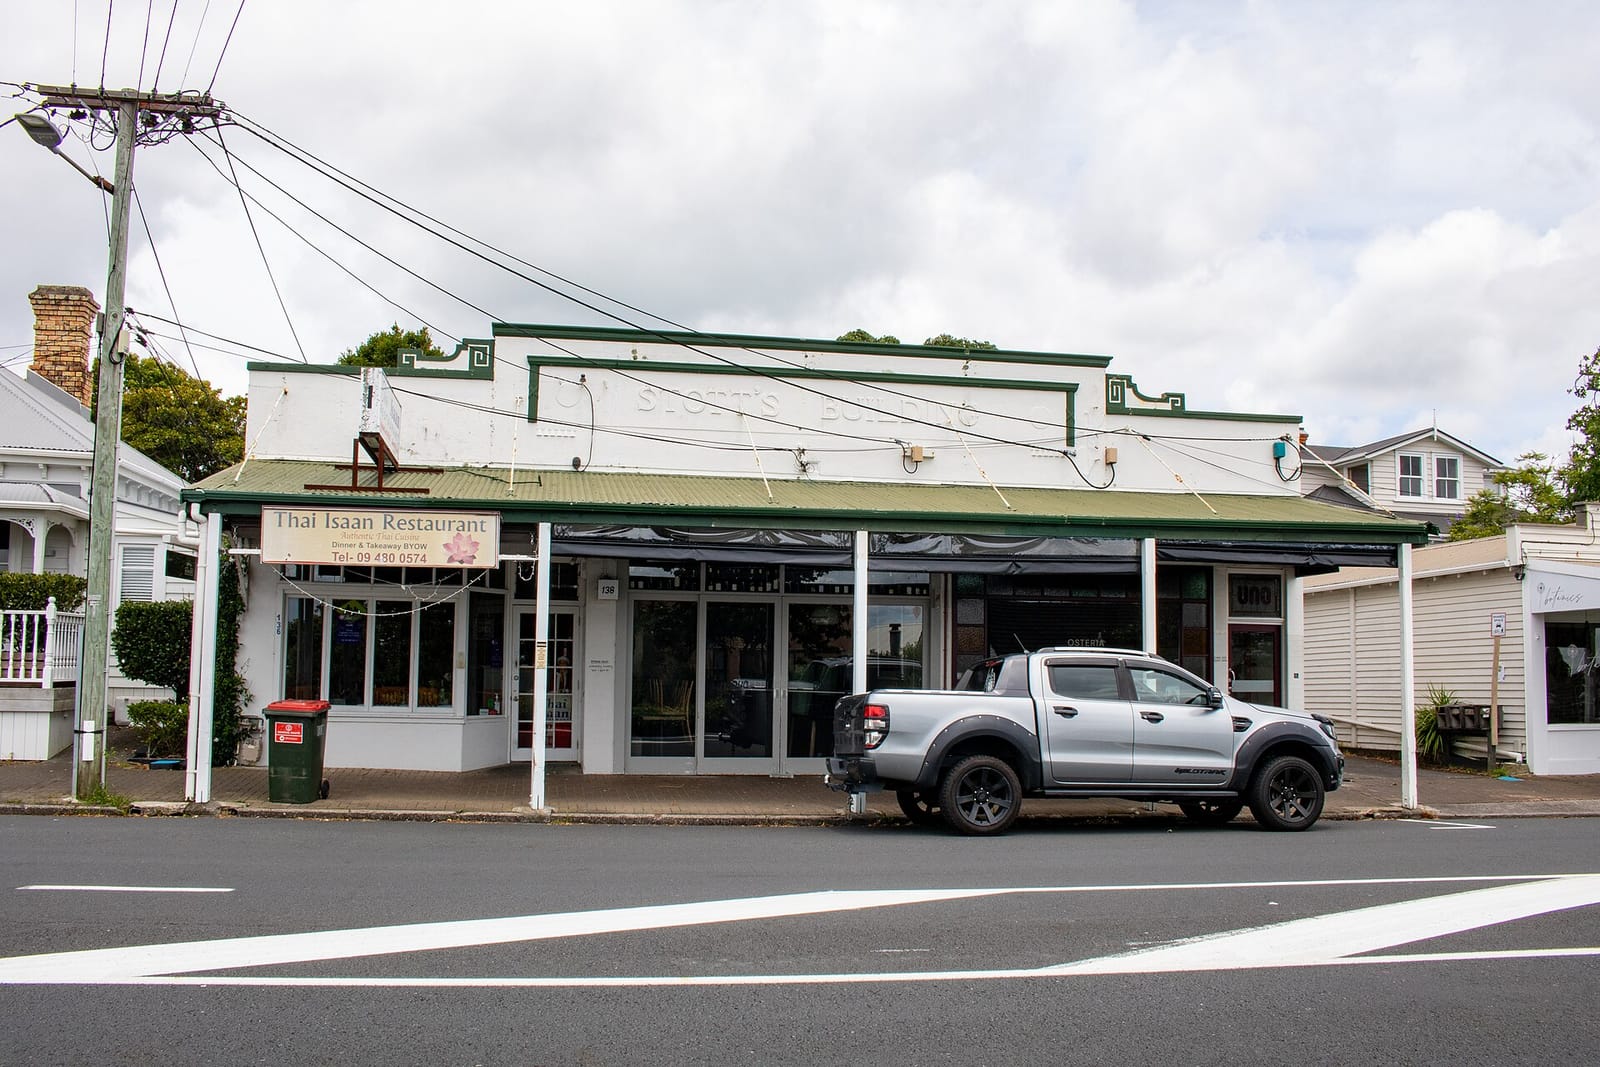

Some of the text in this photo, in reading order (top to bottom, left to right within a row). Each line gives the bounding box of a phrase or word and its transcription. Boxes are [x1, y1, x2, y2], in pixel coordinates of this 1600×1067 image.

[637, 386, 980, 428] STOTT'S BUILDING
[273, 511, 487, 532] Thai Isaan Restaurant
[341, 531, 420, 541] Authentic Thai Cuisine
[331, 541, 428, 551] Dinner & Takeaway BYOW
[332, 551, 428, 564] Tel- 09 480 0574
[601, 585, 615, 594] 138
[1067, 638, 1105, 647] OSTERIA
